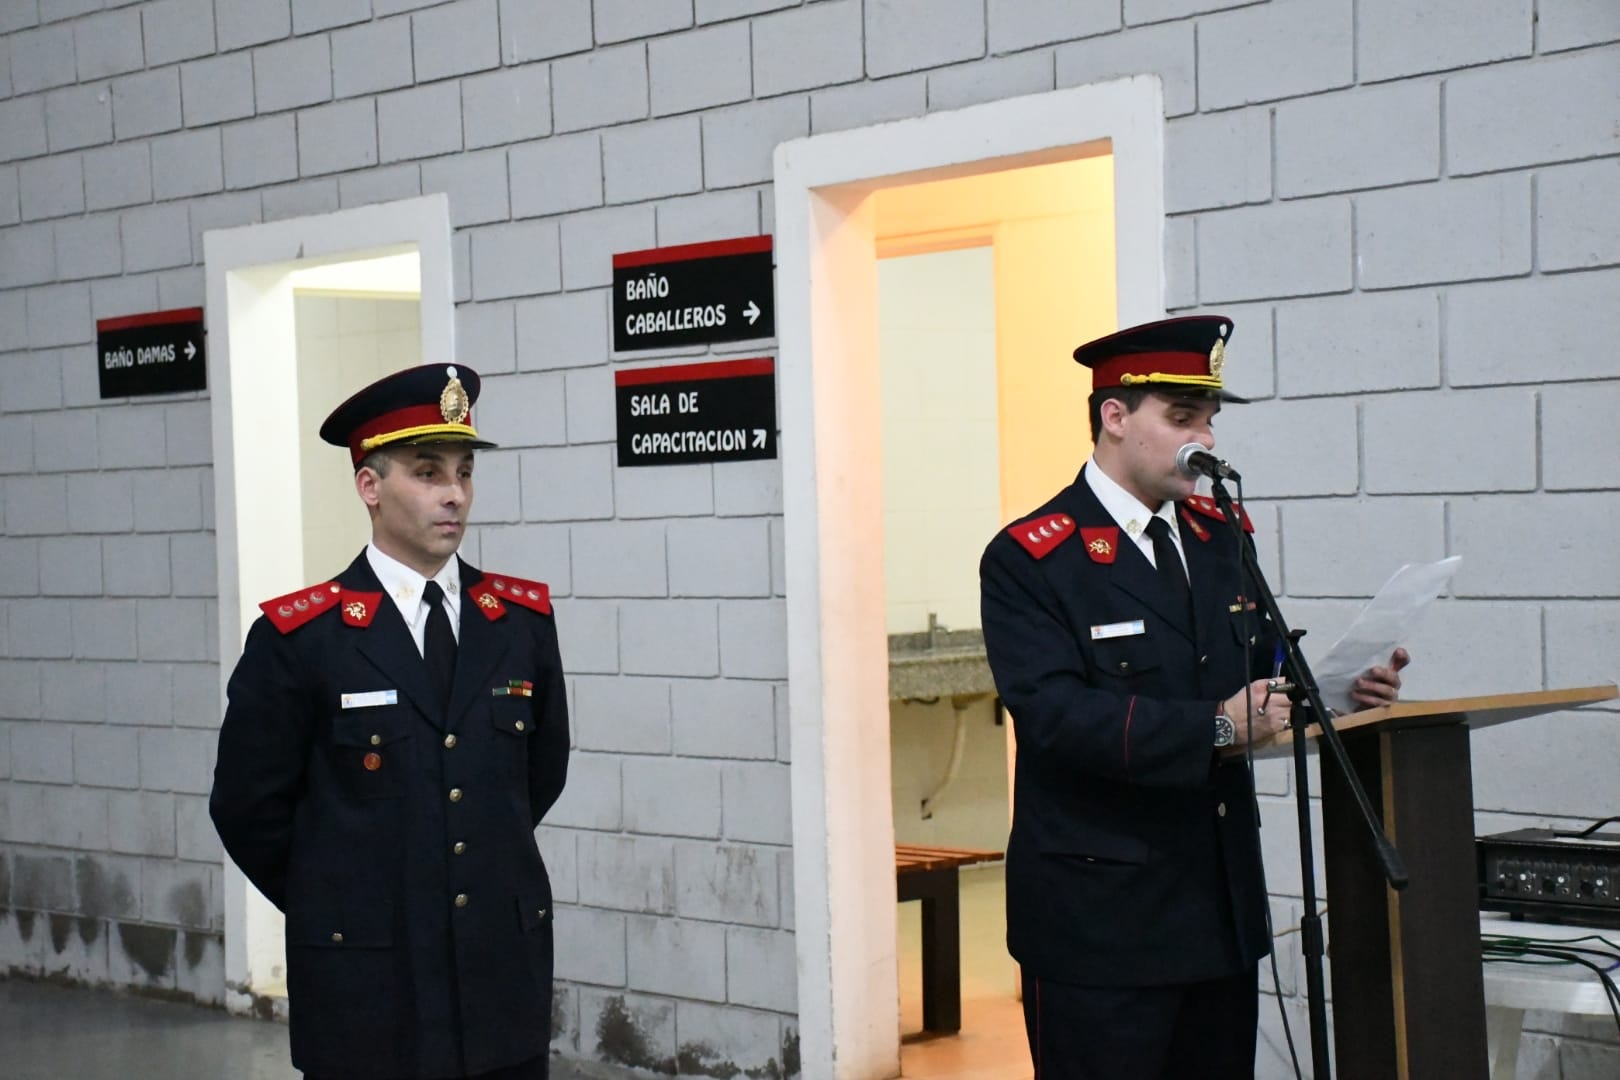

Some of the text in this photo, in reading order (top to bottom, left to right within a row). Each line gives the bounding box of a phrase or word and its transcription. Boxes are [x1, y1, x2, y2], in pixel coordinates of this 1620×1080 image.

[626, 273, 669, 300] BAÑO
[626, 304, 726, 335] CABALLEROS
[105, 344, 175, 369] BAÑO DAMAS
[631, 392, 698, 416] SALA DE
[632, 429, 746, 454] CAPACITACION
